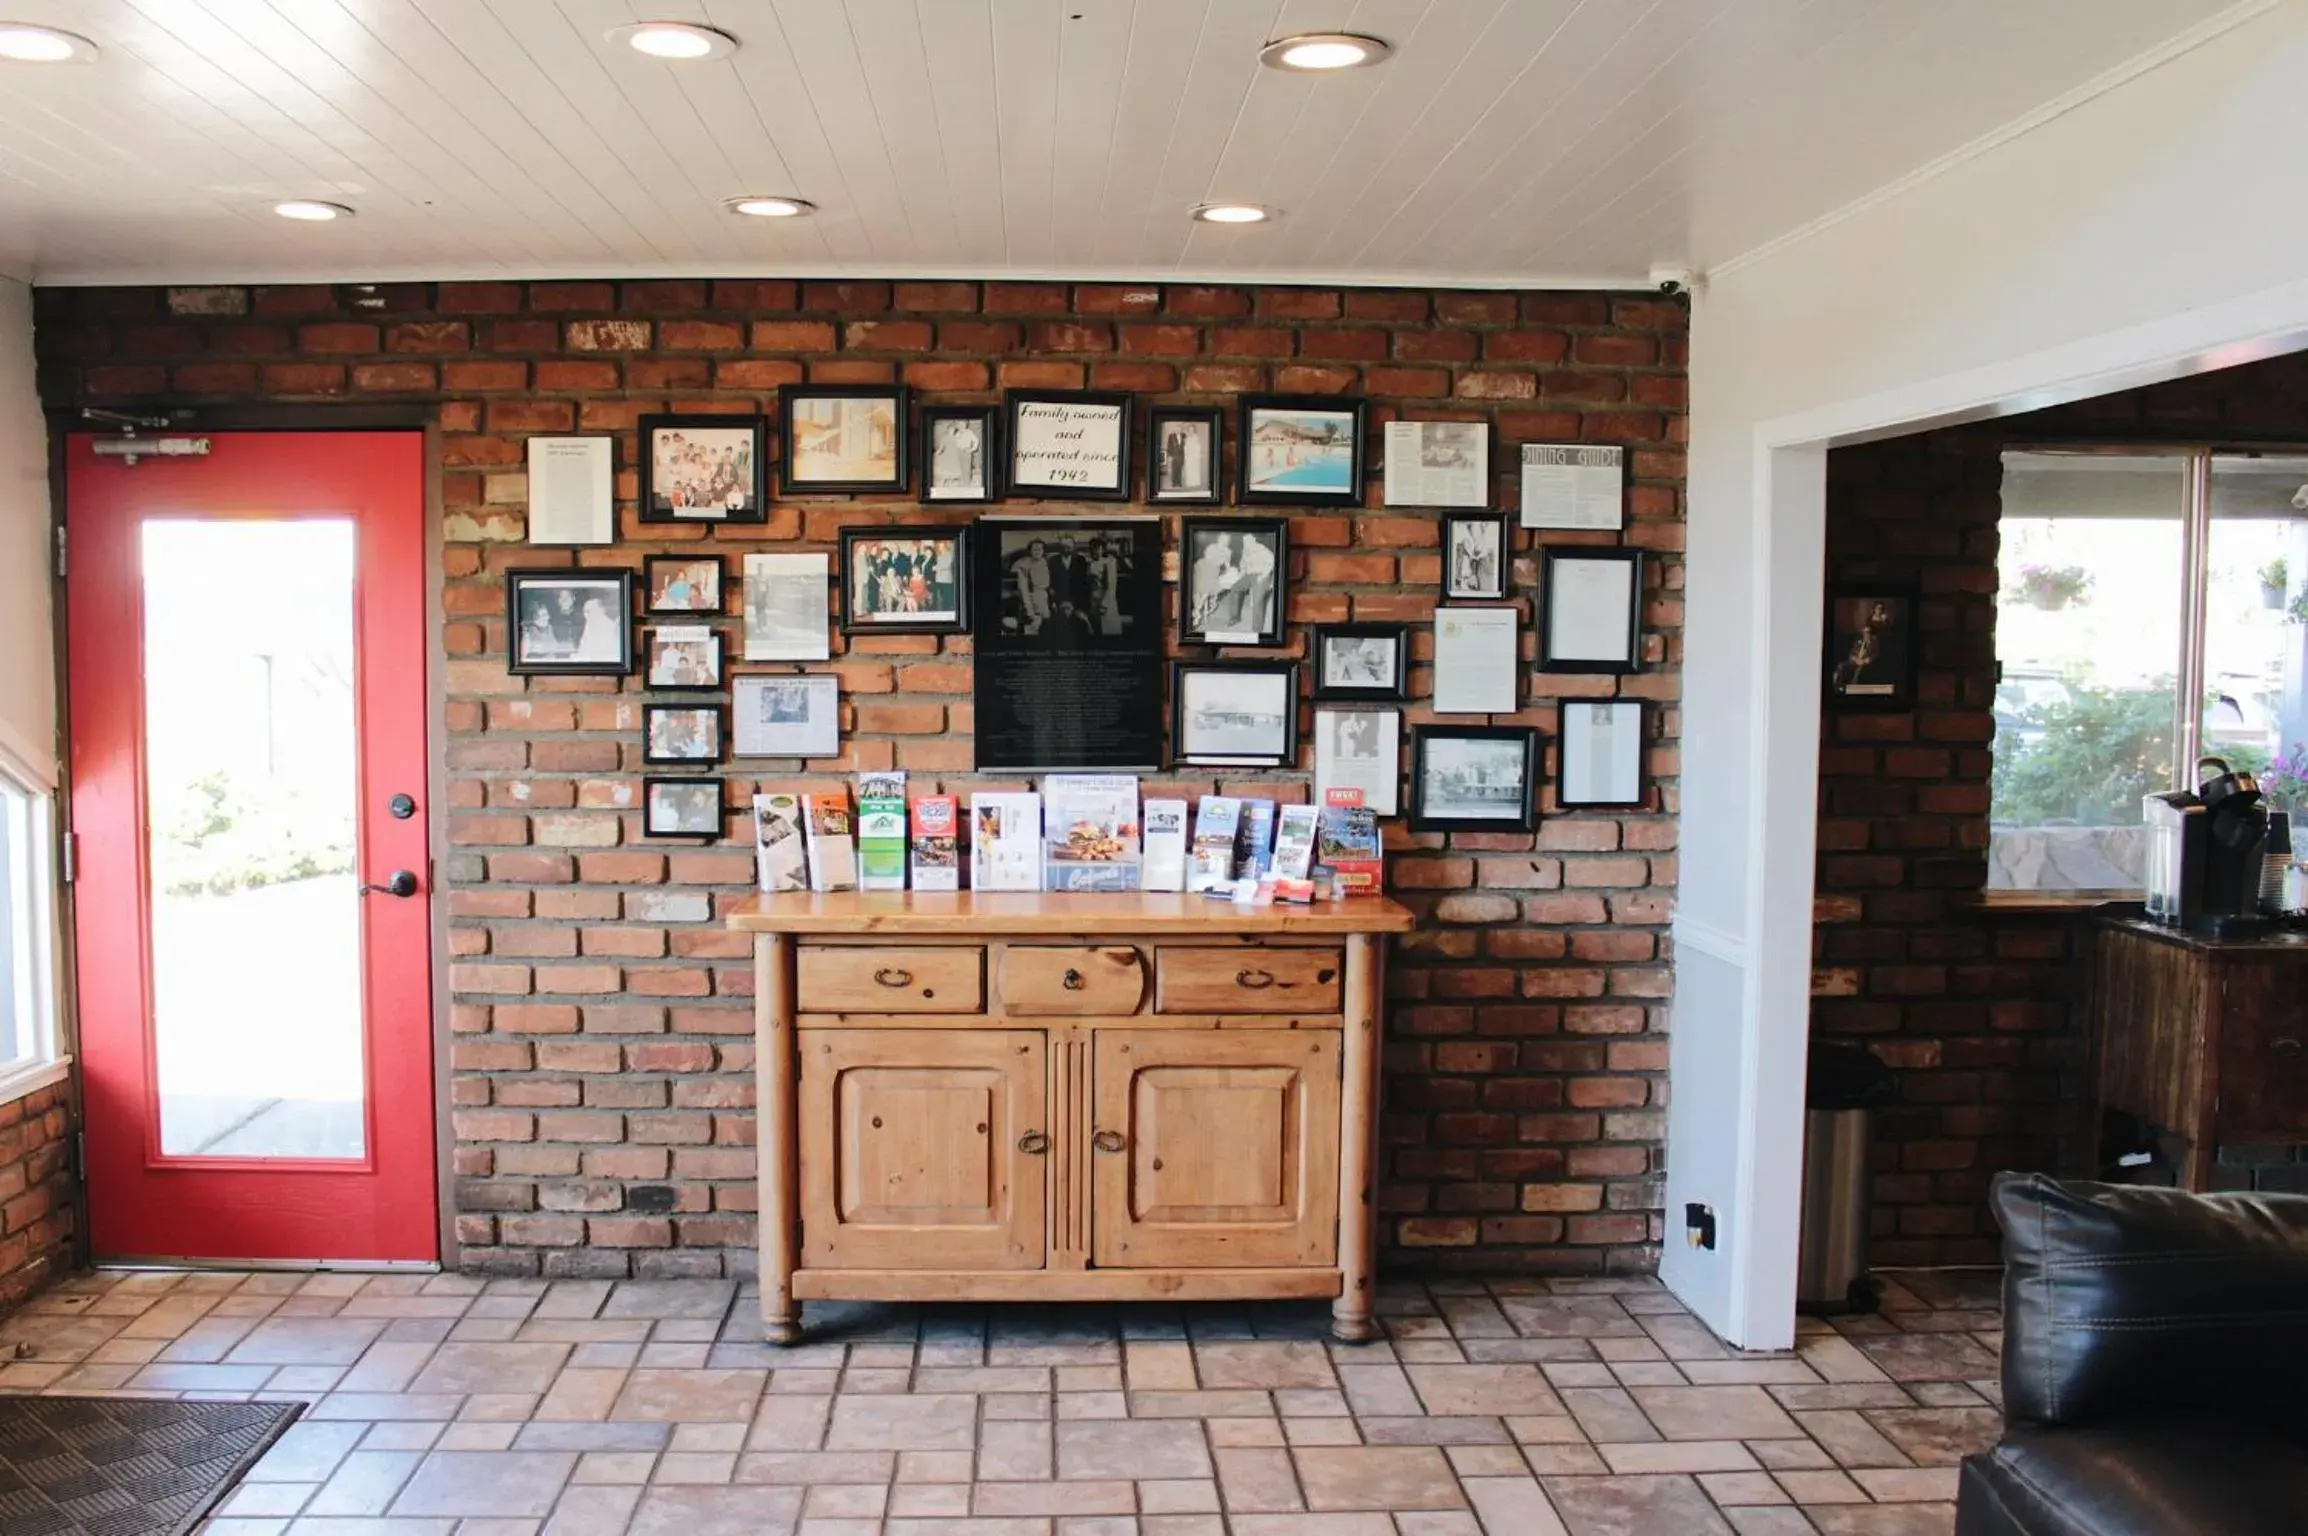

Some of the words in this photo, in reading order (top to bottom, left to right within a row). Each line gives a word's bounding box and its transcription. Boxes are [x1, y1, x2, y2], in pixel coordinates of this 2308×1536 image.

[1020, 404, 1070, 423] Family
[1073, 407, 1121, 421] owned
[1054, 427, 1085, 440] and
[1014, 449, 1080, 463] operated
[1082, 452, 1118, 463] since
[1577, 447, 1620, 468] GUIDE
[1048, 468, 1089, 482] 1942
